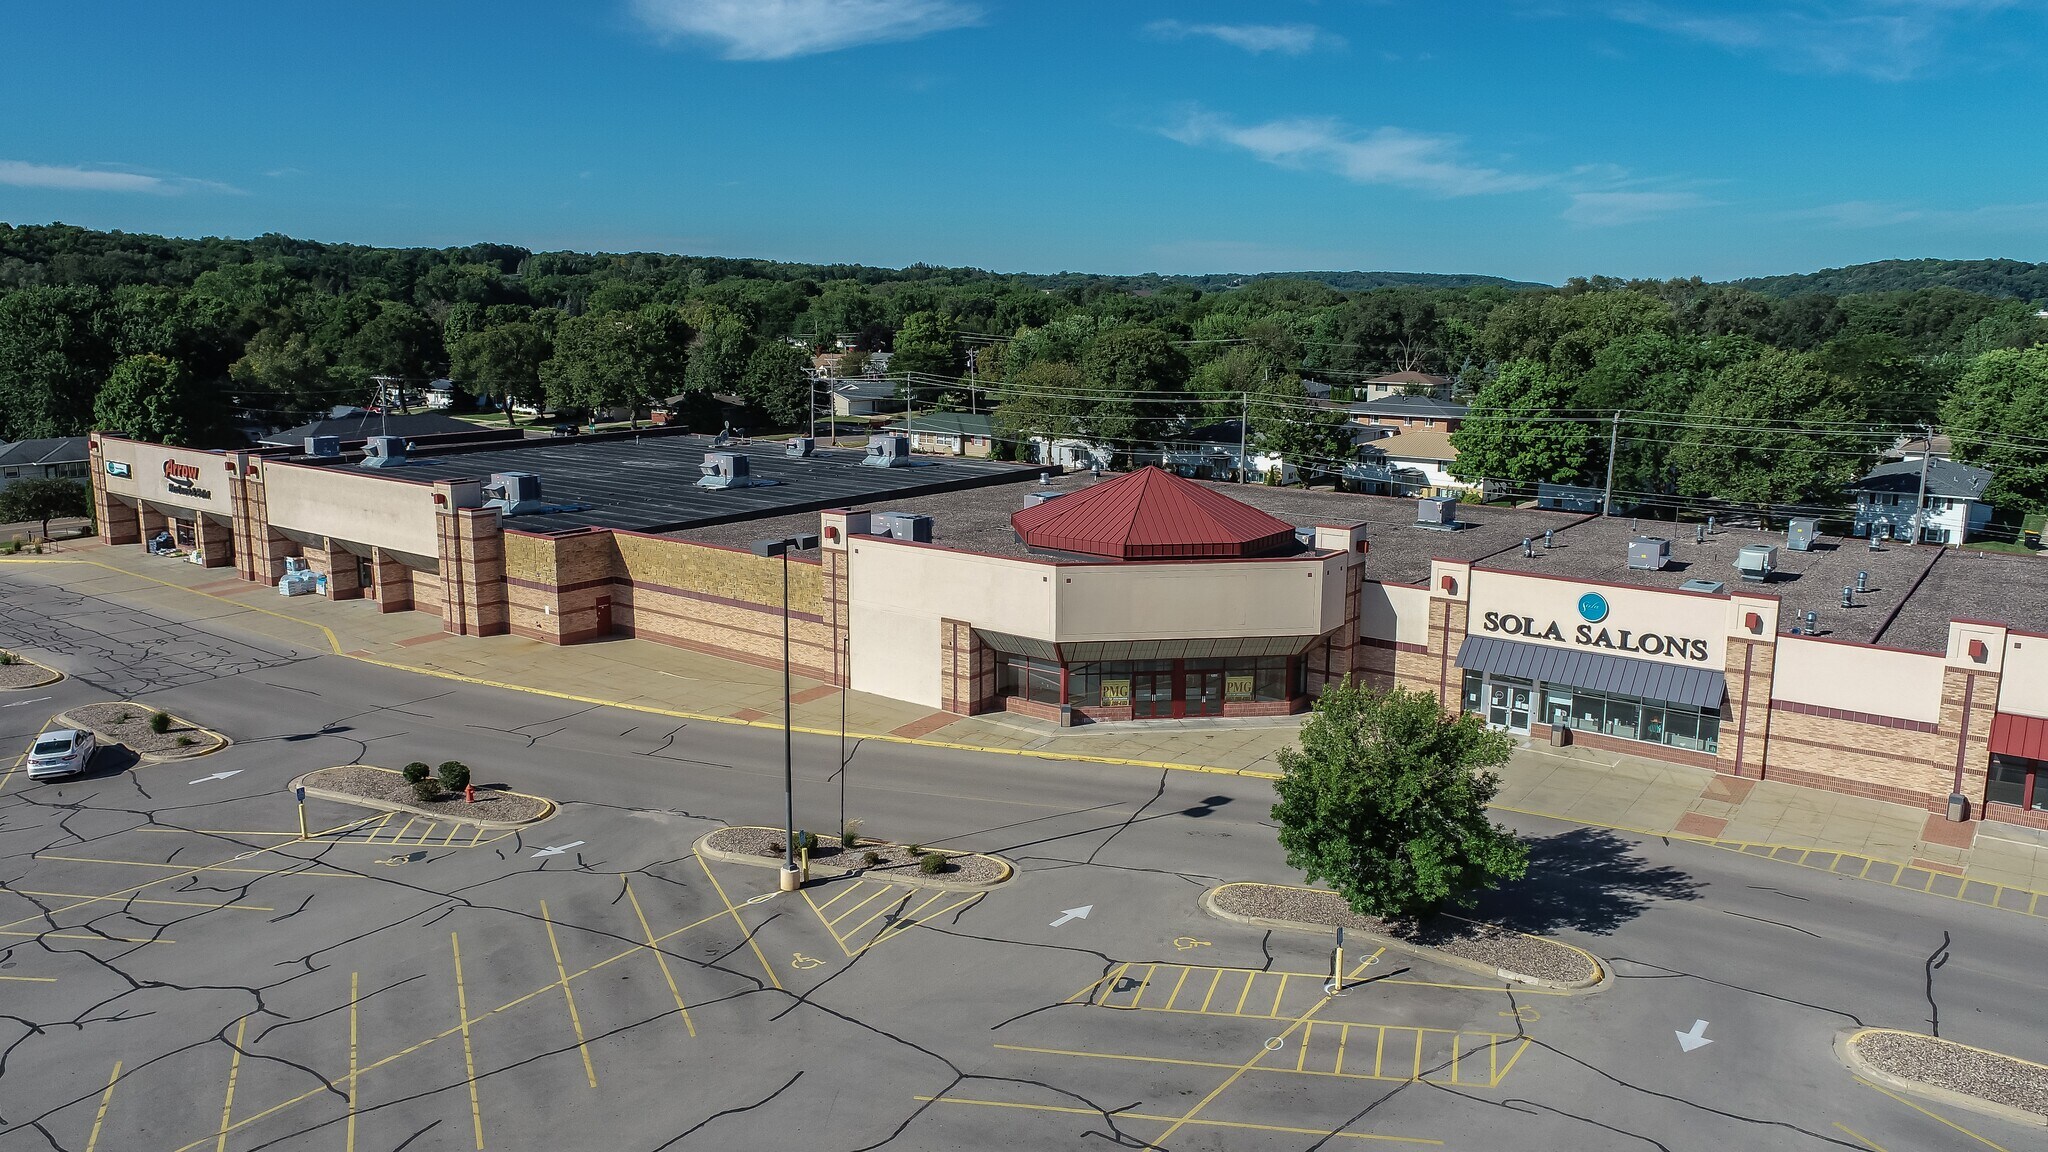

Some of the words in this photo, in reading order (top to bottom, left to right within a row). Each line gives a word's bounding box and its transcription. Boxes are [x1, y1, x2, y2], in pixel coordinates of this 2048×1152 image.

[164, 458, 199, 480] Arrow
[1581, 601, 1600, 613] Sola
[1483, 611, 1566, 643] SOLA
[1575, 624, 1709, 661] SALONS
[1103, 685, 1128, 697] PMG
[1225, 681, 1252, 693] PMG
